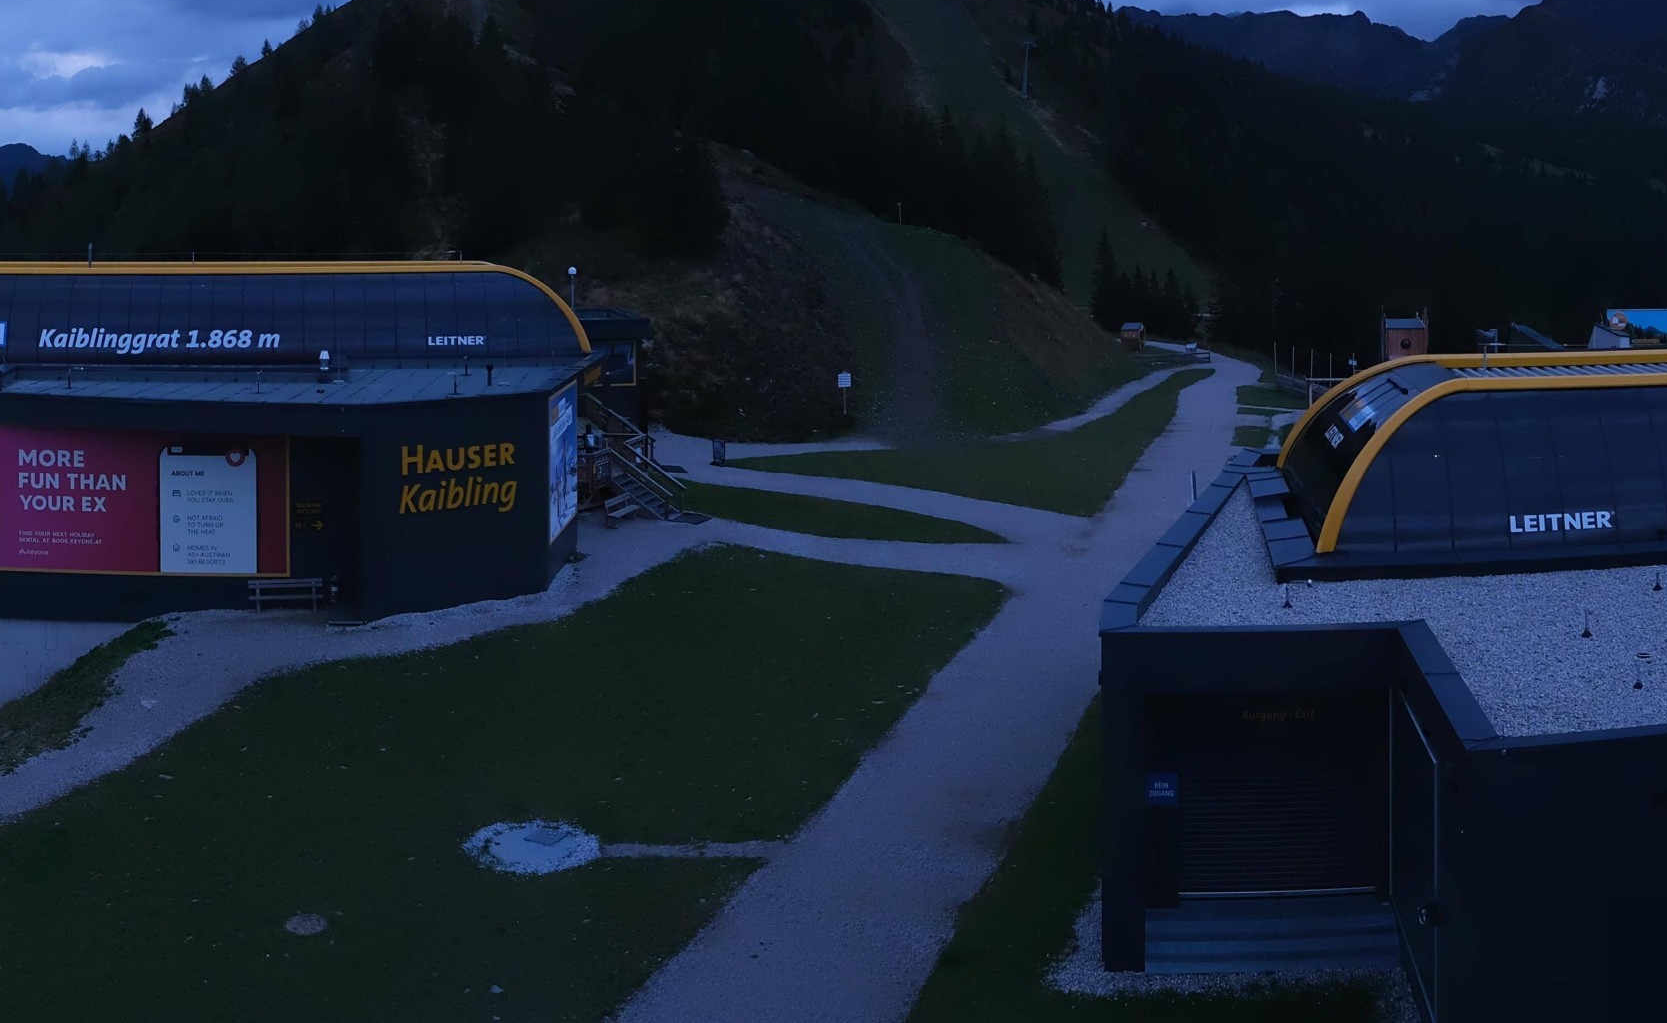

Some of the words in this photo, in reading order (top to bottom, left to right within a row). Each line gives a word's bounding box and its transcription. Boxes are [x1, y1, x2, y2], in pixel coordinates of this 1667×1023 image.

[38, 327, 179, 355] Kaiblinggrat
[186, 328, 251, 349] 1.868
[258, 333, 281, 349] m
[18, 449, 85, 468] MORE
[401, 442, 516, 476] HAUSER
[18, 472, 60, 490] FUN
[67, 473, 127, 491] THAN
[19, 494, 75, 512] YOUR
[82, 496, 107, 513] EX
[399, 477, 519, 514] Kaibling
[26, 548, 49, 556] keyone
[1241, 710, 1287, 721] Ausgang
[1295, 709, 1316, 719] Exit
[1153, 782, 1169, 790] KEIN
